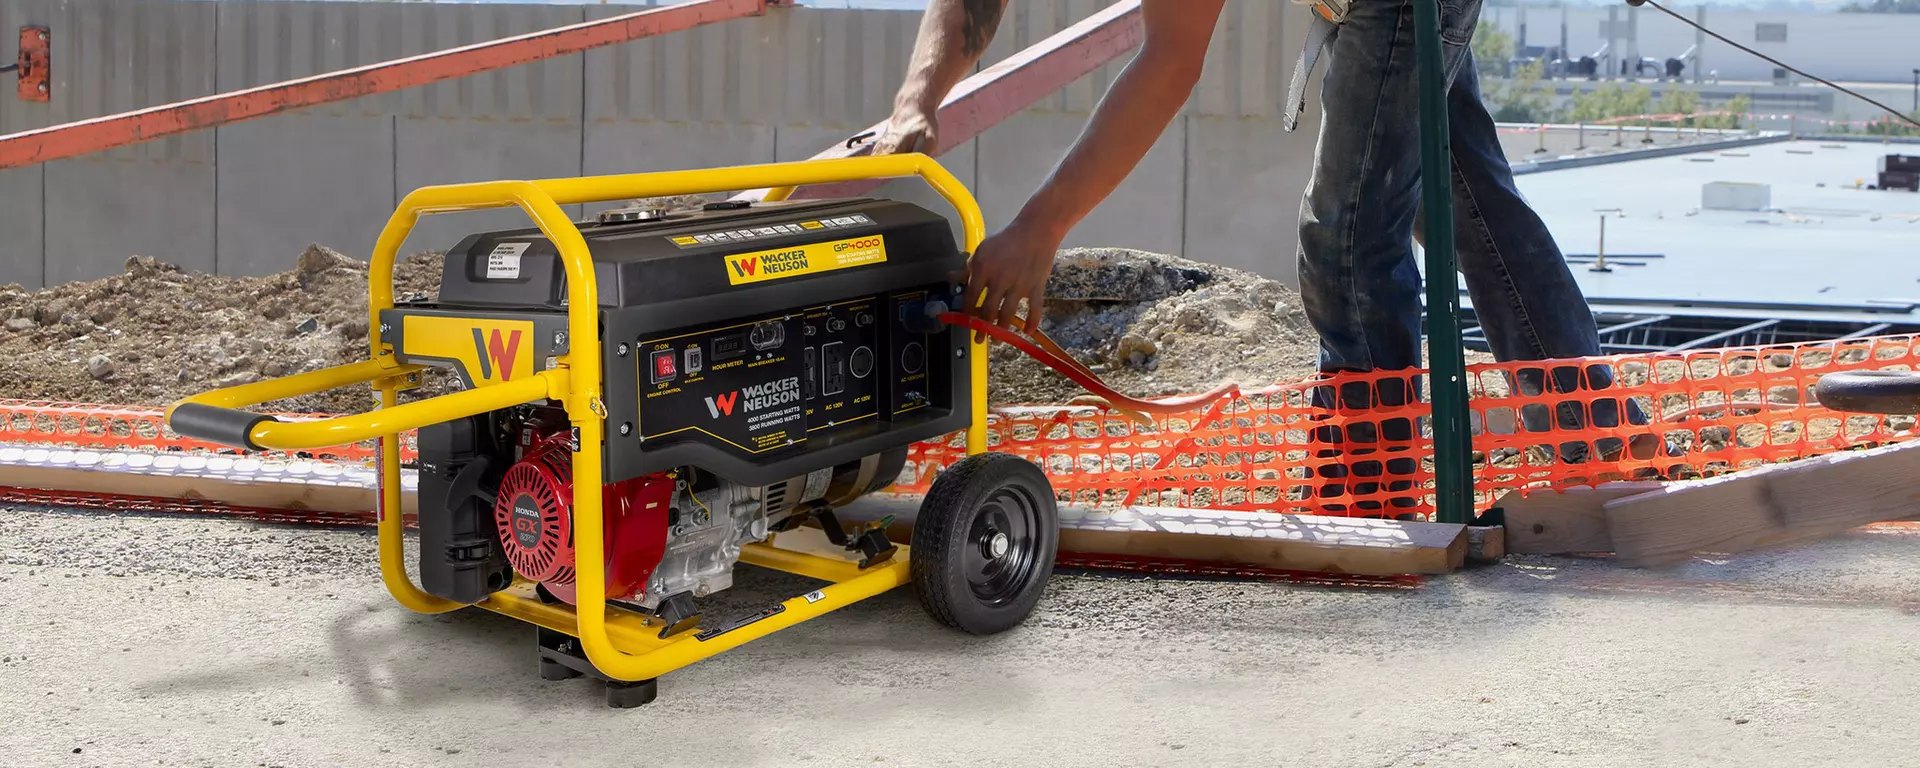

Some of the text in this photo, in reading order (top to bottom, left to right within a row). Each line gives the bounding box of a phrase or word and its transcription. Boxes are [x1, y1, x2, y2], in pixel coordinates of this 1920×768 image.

[834, 238, 880, 252] GP4000
[760, 250, 806, 264] WACKER
[763, 259, 808, 274] NEUSON
[472, 328, 522, 382] W
[758, 358, 775, 366] BREAKER
[712, 359, 744, 371] HOUR METER
[662, 387, 681, 395] CONTROL
[742, 376, 799, 400] WACKER
[704, 391, 738, 419] W
[744, 388, 800, 413] NEUSON
[760, 410, 783, 421] STARTING
[784, 406, 800, 414] WATTS
[761, 418, 784, 428] RUNNING
[784, 414, 801, 422] WATTS
[515, 506, 539, 518] HONDA
[516, 517, 538, 534] GX
